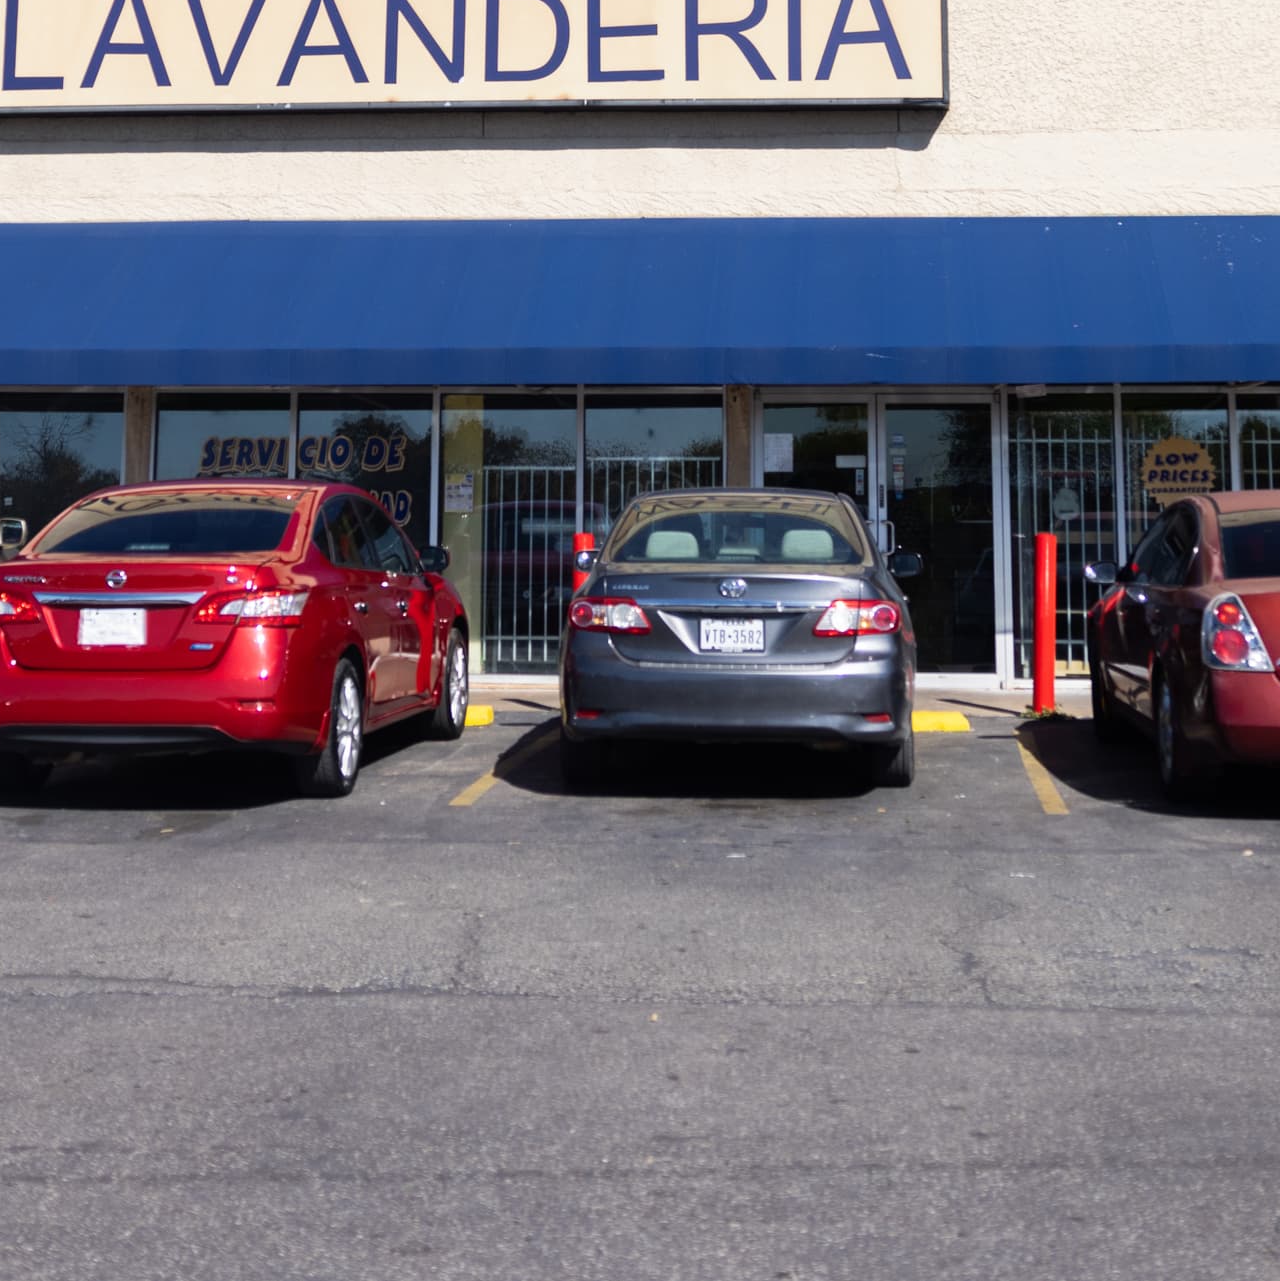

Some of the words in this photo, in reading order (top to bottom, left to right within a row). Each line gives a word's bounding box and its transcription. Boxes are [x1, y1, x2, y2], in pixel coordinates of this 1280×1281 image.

[197, 433, 353, 472] SERVICIO
[361, 433, 408, 472] DE
[1154, 452, 1200, 467] LOW
[1147, 469, 1210, 483] PRICES
